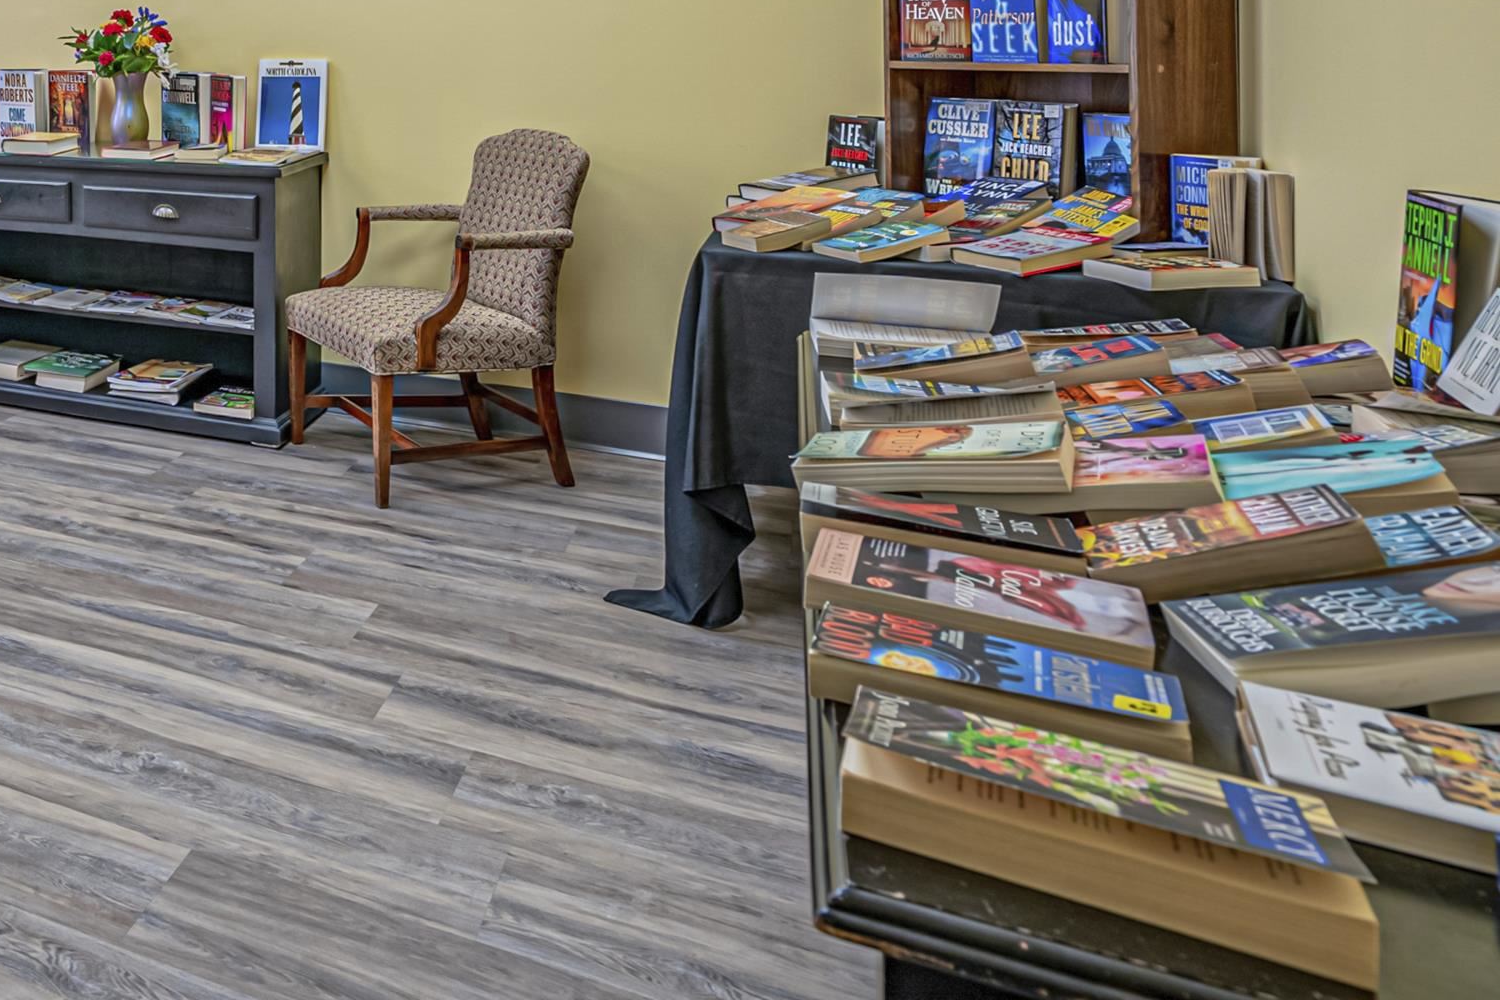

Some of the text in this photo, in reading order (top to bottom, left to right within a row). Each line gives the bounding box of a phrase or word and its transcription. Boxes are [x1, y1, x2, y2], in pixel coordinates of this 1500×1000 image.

[905, 3, 965, 23] HEAVEN
[973, 8, 1036, 26] Patterson
[971, 22, 1038, 54] SEEK
[1053, 13, 1095, 47] dust
[4, 73, 27, 88] NORA
[49, 73, 87, 83] DANIELLE
[286, 67, 317, 76] CAROLINA
[0, 88, 34, 103] ROBERTS
[57, 83, 80, 91] STEEL
[9, 107, 26, 122] COME
[937, 103, 980, 121] CLIVE
[840, 123, 862, 147] LEE
[928, 119, 989, 138] CUSSLER
[1013, 113, 1042, 140] LEE
[1000, 142, 1052, 157] JACK REACHER
[970, 179, 1027, 193] VINCE
[1070, 204, 1108, 219] JAMES
[1176, 203, 1189, 215] THE
[1406, 202, 1445, 244] TEPHEN
[1403, 234, 1451, 285] ANNELL
[1405, 328, 1419, 360] THE
[1420, 337, 1442, 374] GRIND
[1009, 519, 1038, 535] SUE
[1138, 517, 1178, 549] DEADLY
[955, 568, 995, 608] Tattoo
[1001, 570, 1043, 607] Coal
[1300, 594, 1384, 631] SECRET
[1326, 587, 1426, 632] HOUSE
[1380, 593, 1460, 624] LAKE
[815, 604, 880, 660] BLOOD
[879, 612, 941, 647] BAD
[1185, 598, 1275, 652] BURROUGHS
[1225, 608, 1280, 637] DEBRA
